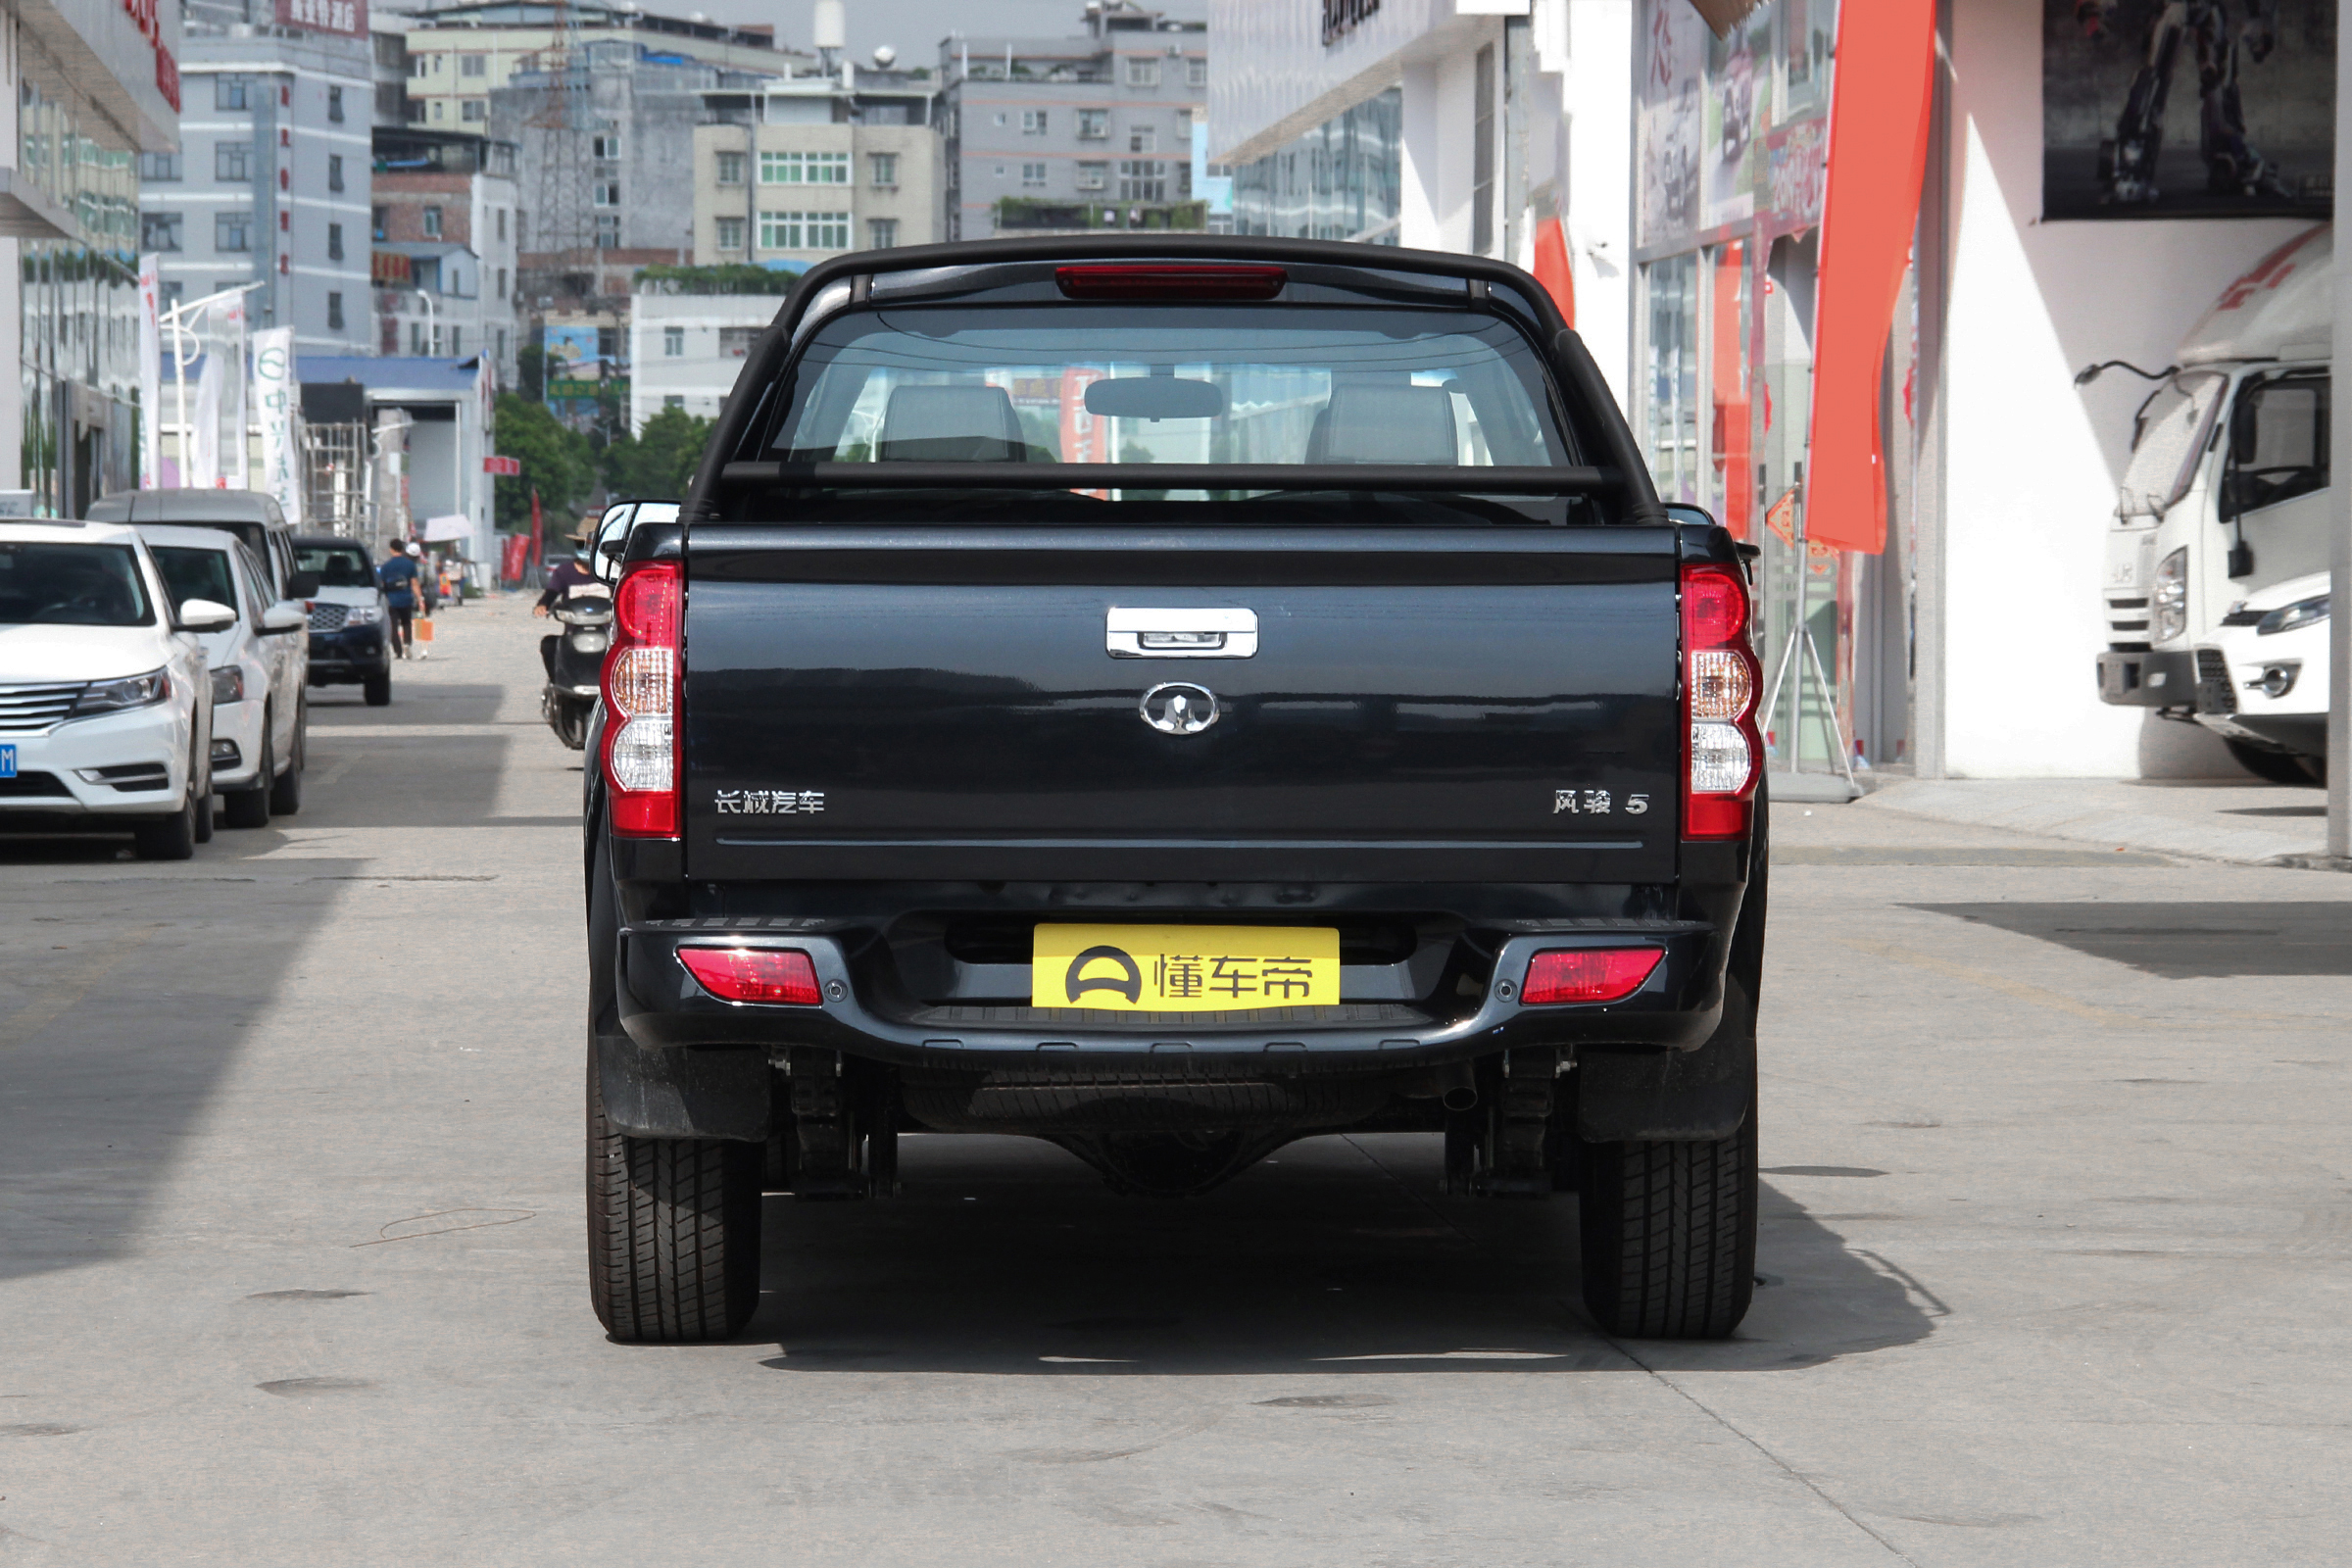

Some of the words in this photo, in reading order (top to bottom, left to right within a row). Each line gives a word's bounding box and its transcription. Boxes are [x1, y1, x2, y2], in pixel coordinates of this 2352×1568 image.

[714, 789, 825, 814] 长城汽车
[1552, 789, 1611, 814] 风骏
[1625, 794, 1650, 815] 5
[1153, 953, 1313, 1000] 懂车帝
